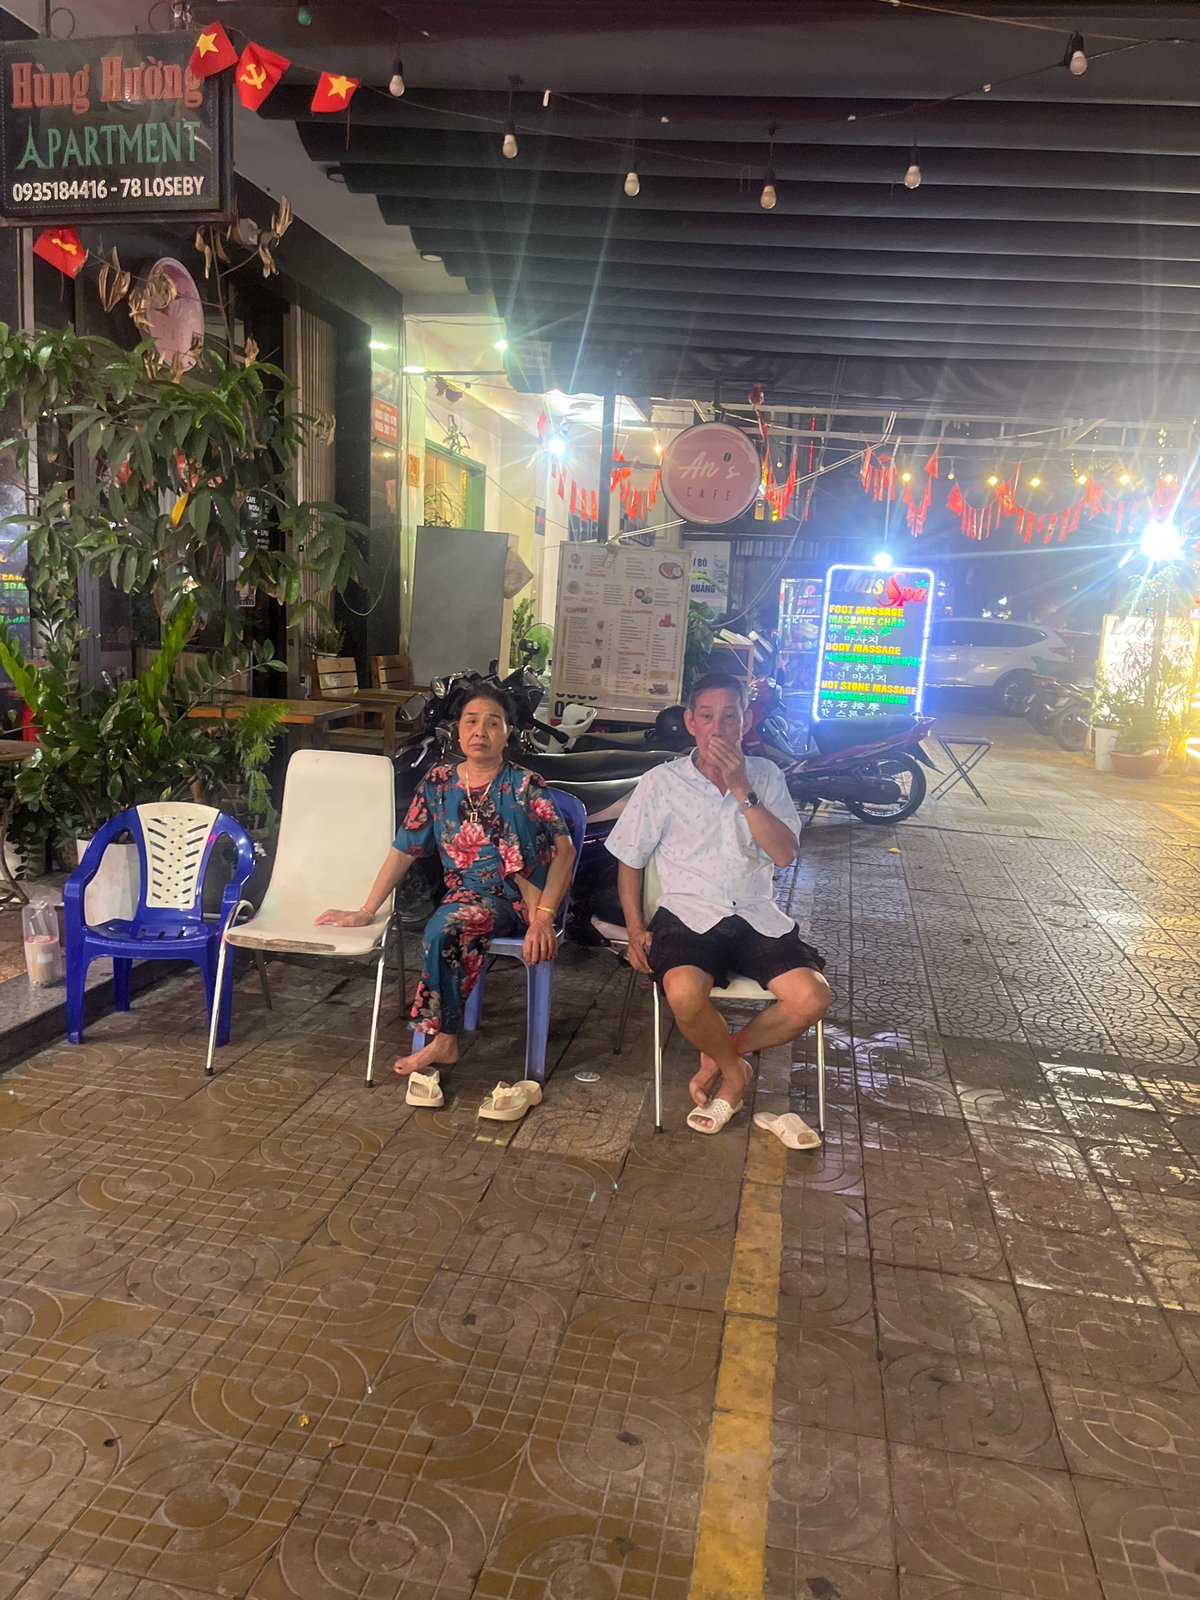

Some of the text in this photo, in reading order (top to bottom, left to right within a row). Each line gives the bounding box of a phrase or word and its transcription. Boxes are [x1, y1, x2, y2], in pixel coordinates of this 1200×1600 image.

[11, 56, 204, 114] Hùng Hường
[15, 116, 203, 170] APARTMENT
[12, 179, 108, 202] 0935184416
[120, 178, 142, 198] 78
[145, 176, 204, 197] LOSEBY
[687, 487, 731, 501] CAFE
[877, 571, 927, 607] Spa
[829, 604, 904, 617] FOOT MASSAGE
[828, 615, 875, 626] MASSAGE
[825, 642, 901, 655] BODY MASSAGE
[824, 653, 868, 663] MASSAGE
[852, 672, 887, 683] 마사지
[821, 680, 918, 695] HOT STONE MASSAGE
[820, 690, 865, 702] MASSAGE
